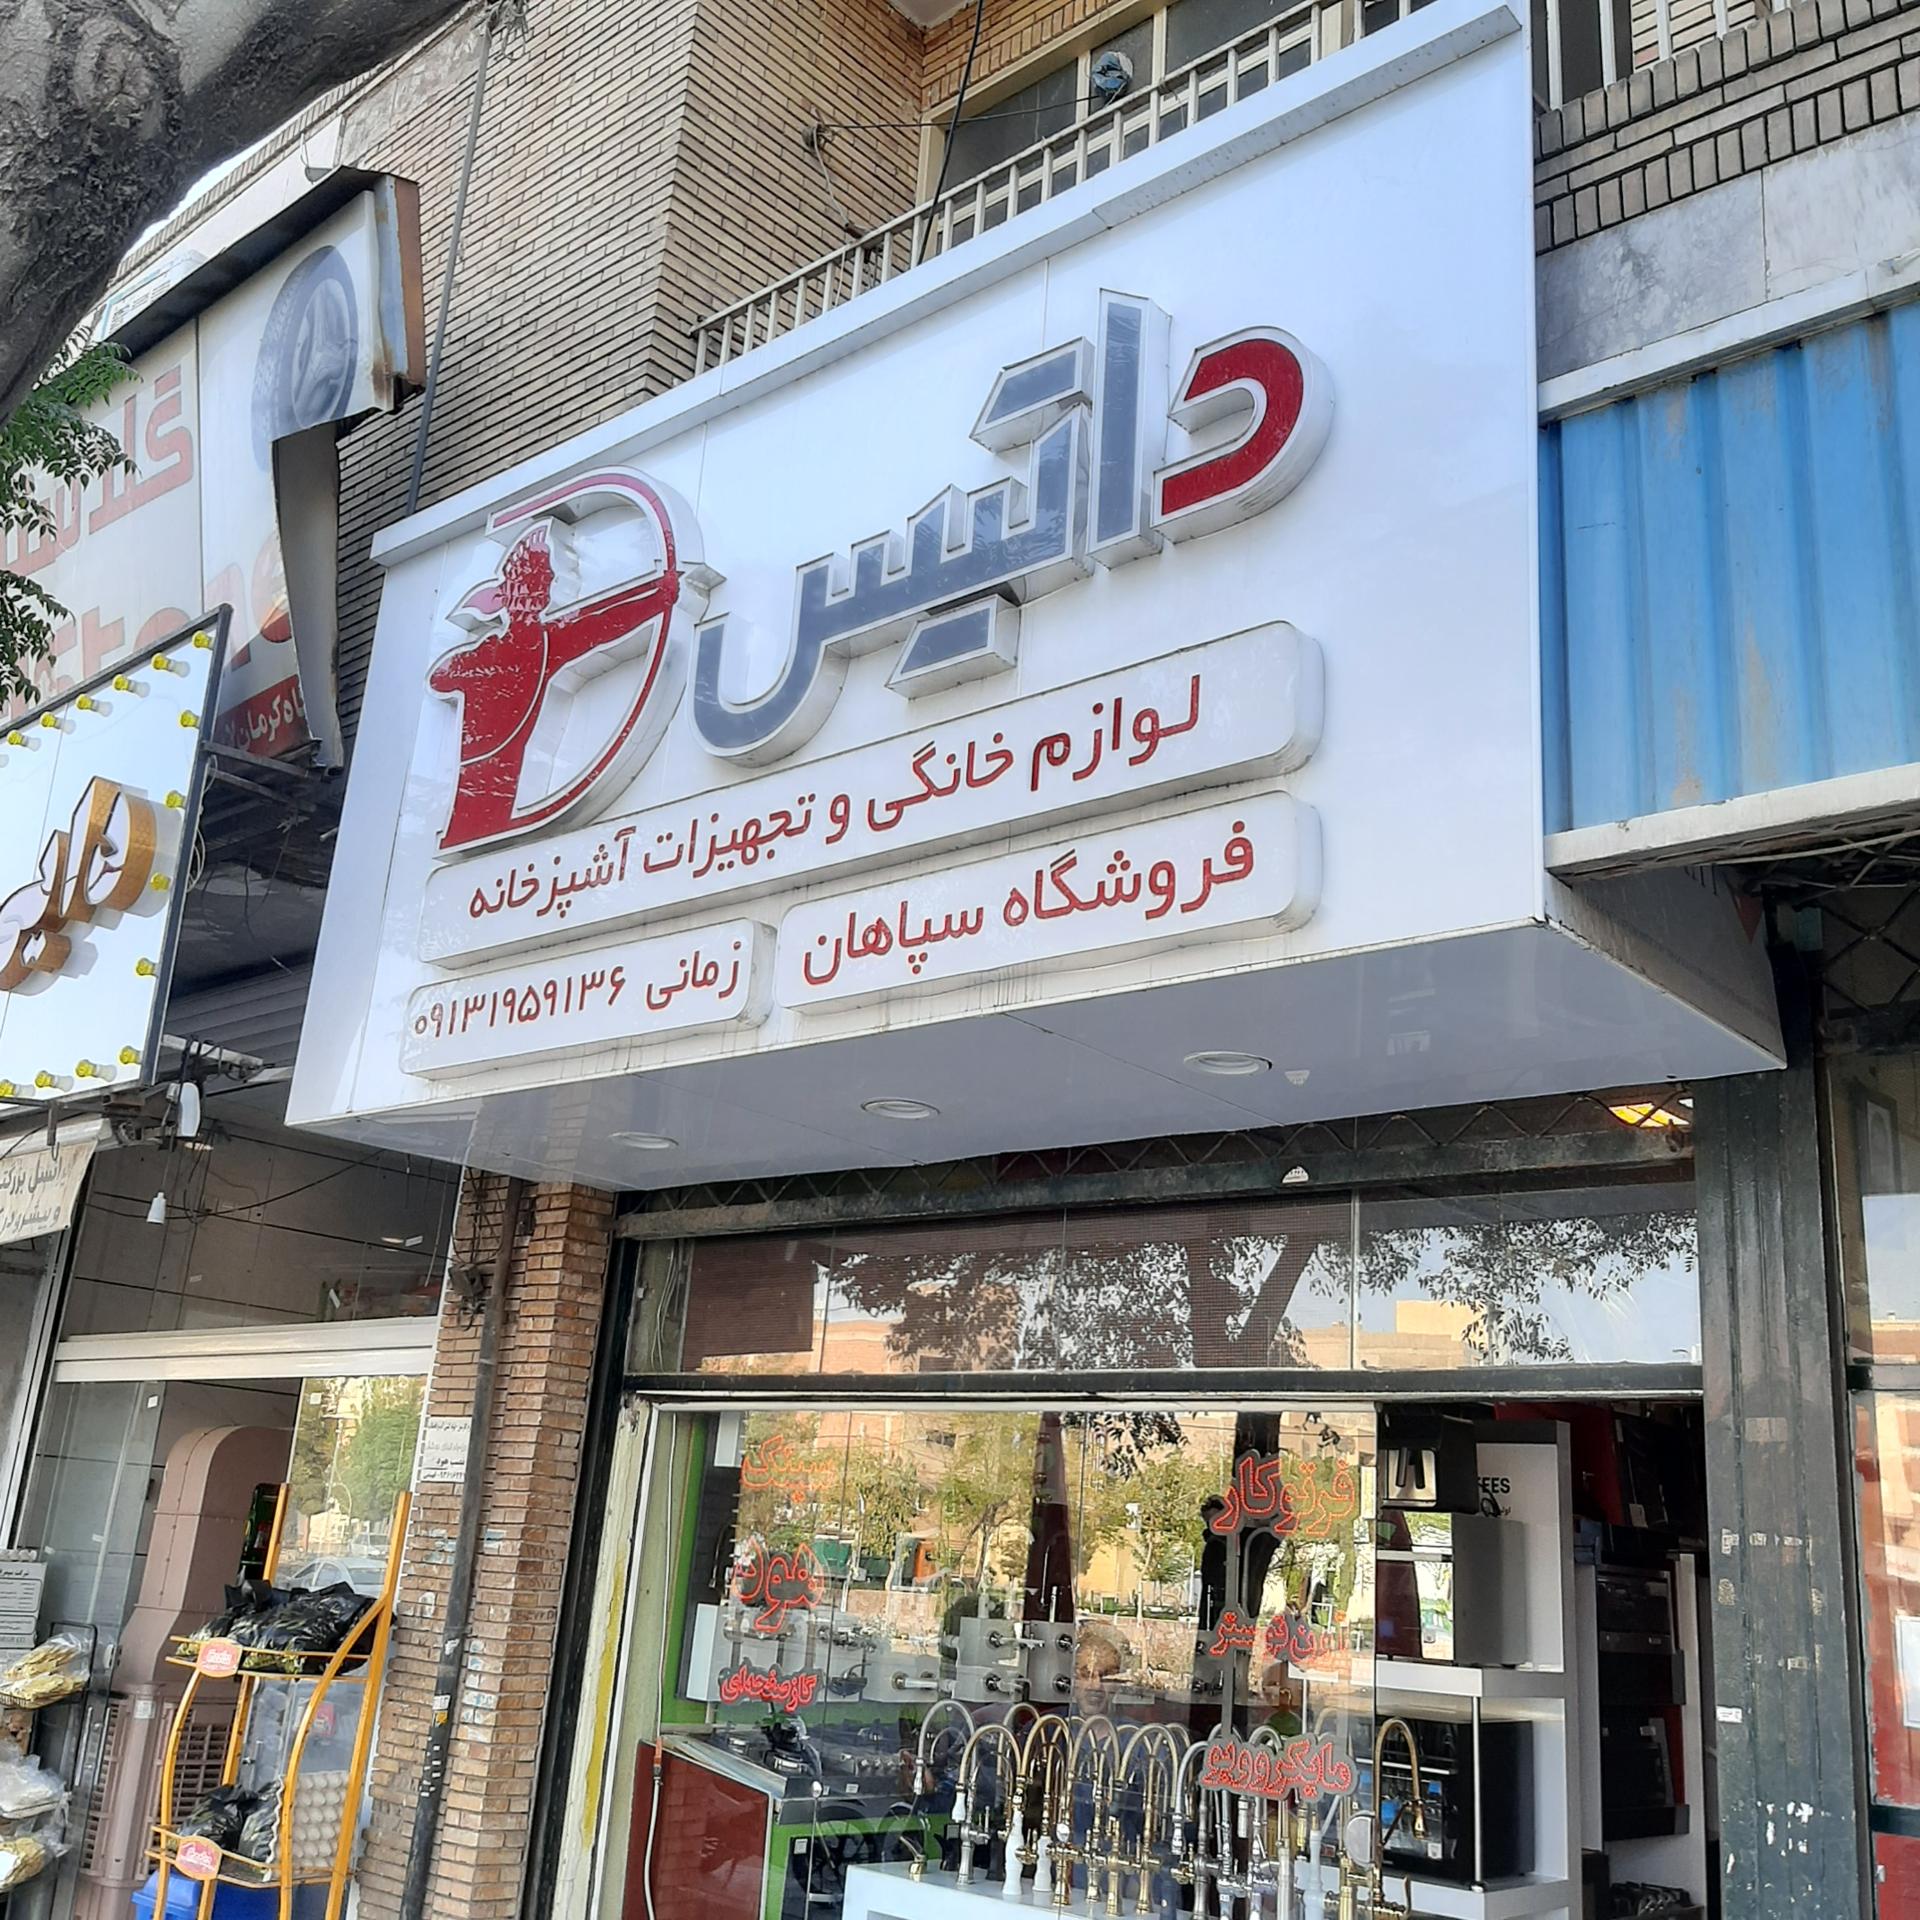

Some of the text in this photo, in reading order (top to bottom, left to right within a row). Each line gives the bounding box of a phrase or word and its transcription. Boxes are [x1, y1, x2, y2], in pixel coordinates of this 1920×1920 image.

[694, 290, 1310, 758] داتیس
[470, 675, 1200, 919] لوازم خانگی و تجهیزات آشپزخانه
[803, 820, 1255, 986] فروشگاه سپاهان
[414, 942, 741, 1038] زمانی ۰۹۱۳۱۹۵۹۱۳۶
[740, 1435, 838, 1504] سینک
[733, 1537, 824, 1632] هود
